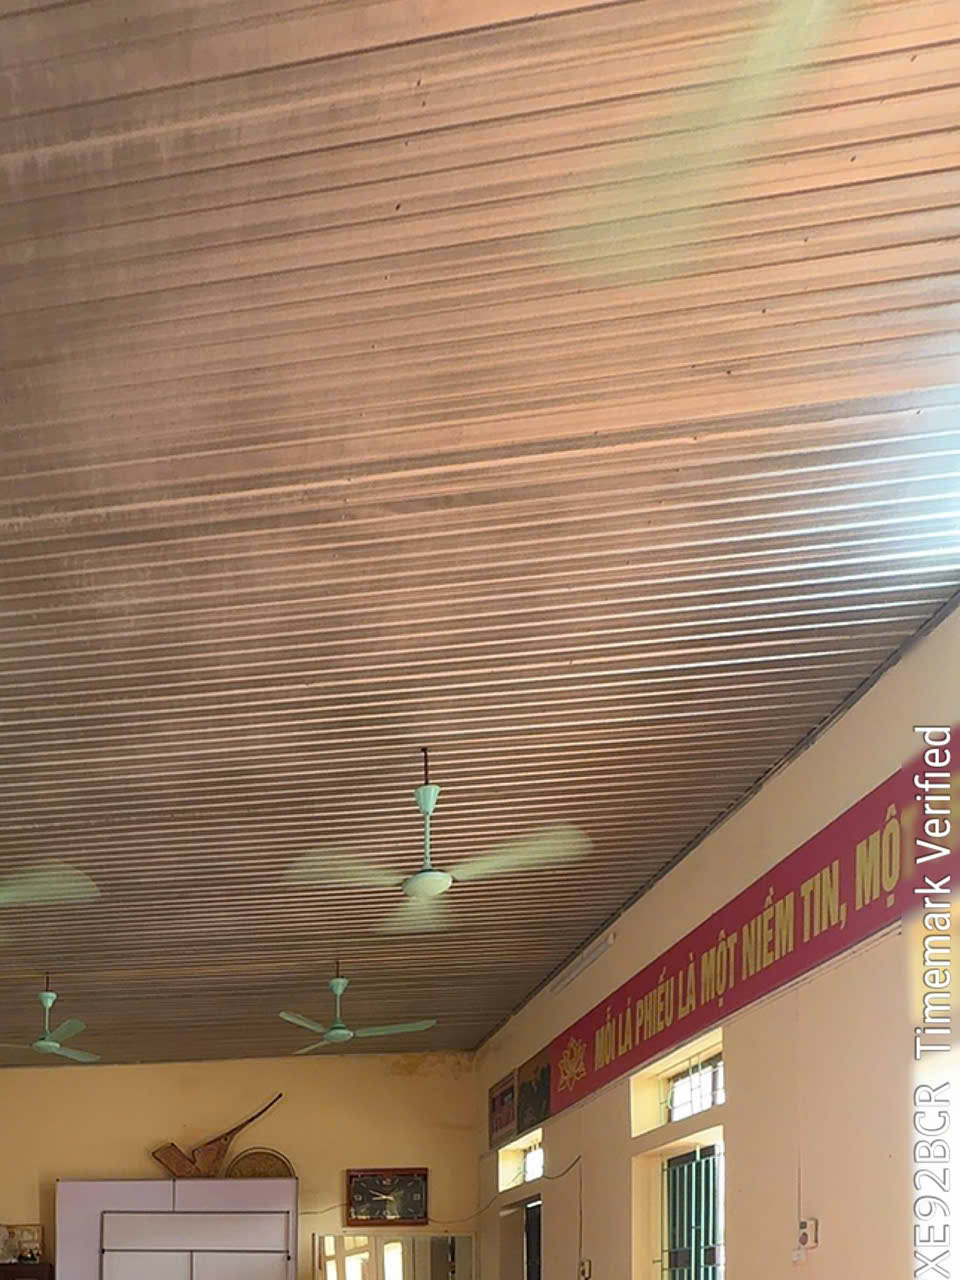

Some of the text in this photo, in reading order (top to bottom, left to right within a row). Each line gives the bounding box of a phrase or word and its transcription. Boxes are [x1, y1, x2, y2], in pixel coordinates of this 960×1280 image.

[595, 1006, 616, 1071] MỖI
[618, 996, 633, 1056] LÁ
[635, 966, 675, 1045] PHIẾU
[678, 951, 696, 1019] LÀ
[700, 929, 738, 1008] MỘT
[742, 886, 795, 981] NIỀM
[800, 859, 848, 943] TIN,
